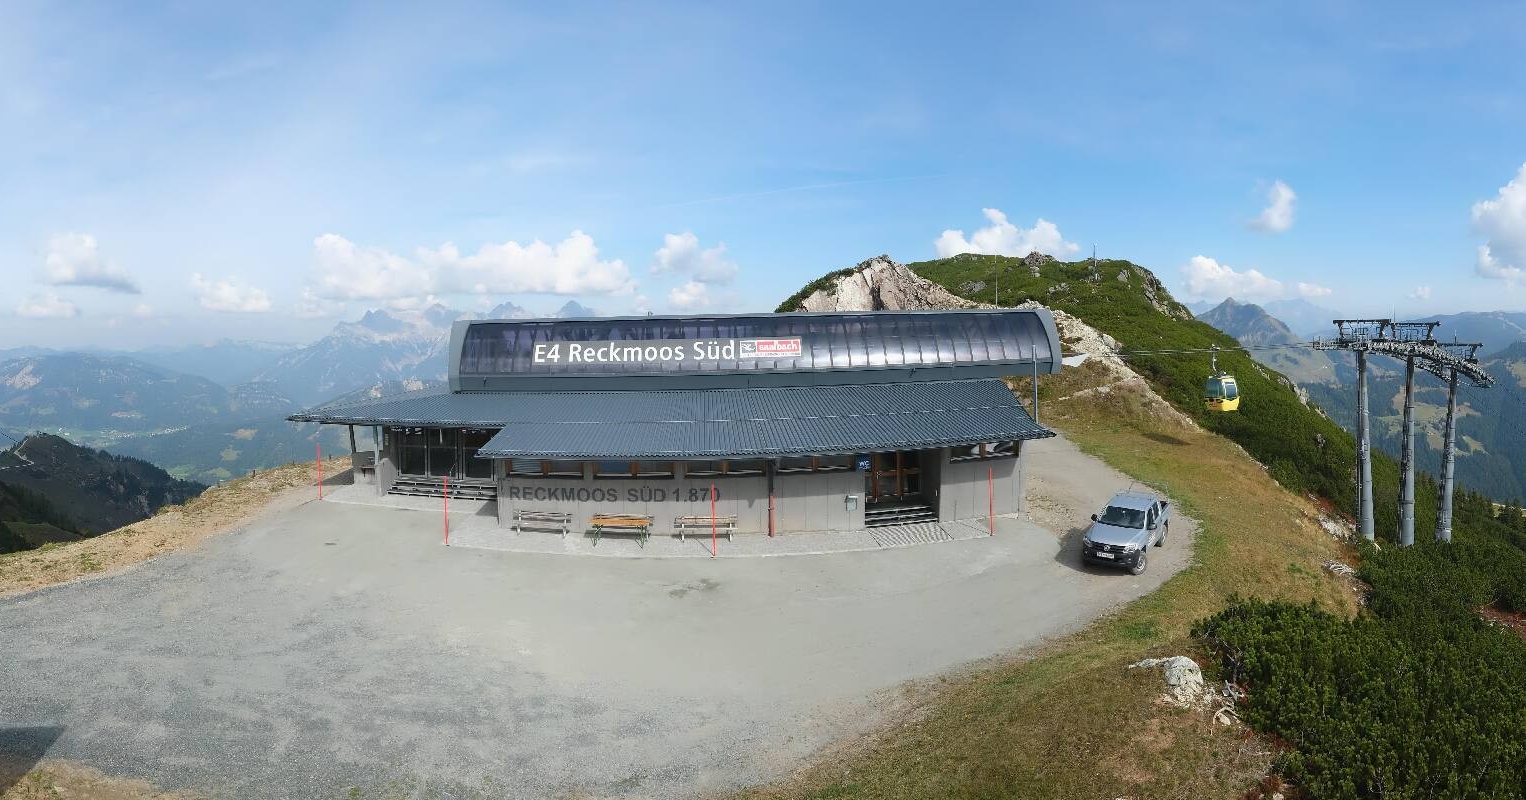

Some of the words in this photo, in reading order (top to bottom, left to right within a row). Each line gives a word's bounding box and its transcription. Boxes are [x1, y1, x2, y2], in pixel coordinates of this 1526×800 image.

[535, 344, 560, 363] E4
[569, 342, 685, 362] Reckmoos
[694, 341, 736, 360] Süd
[759, 340, 798, 351] saalbach
[509, 486, 617, 502] RECKMOOS
[627, 486, 667, 502] SÜD
[672, 488, 721, 502] 1.870
